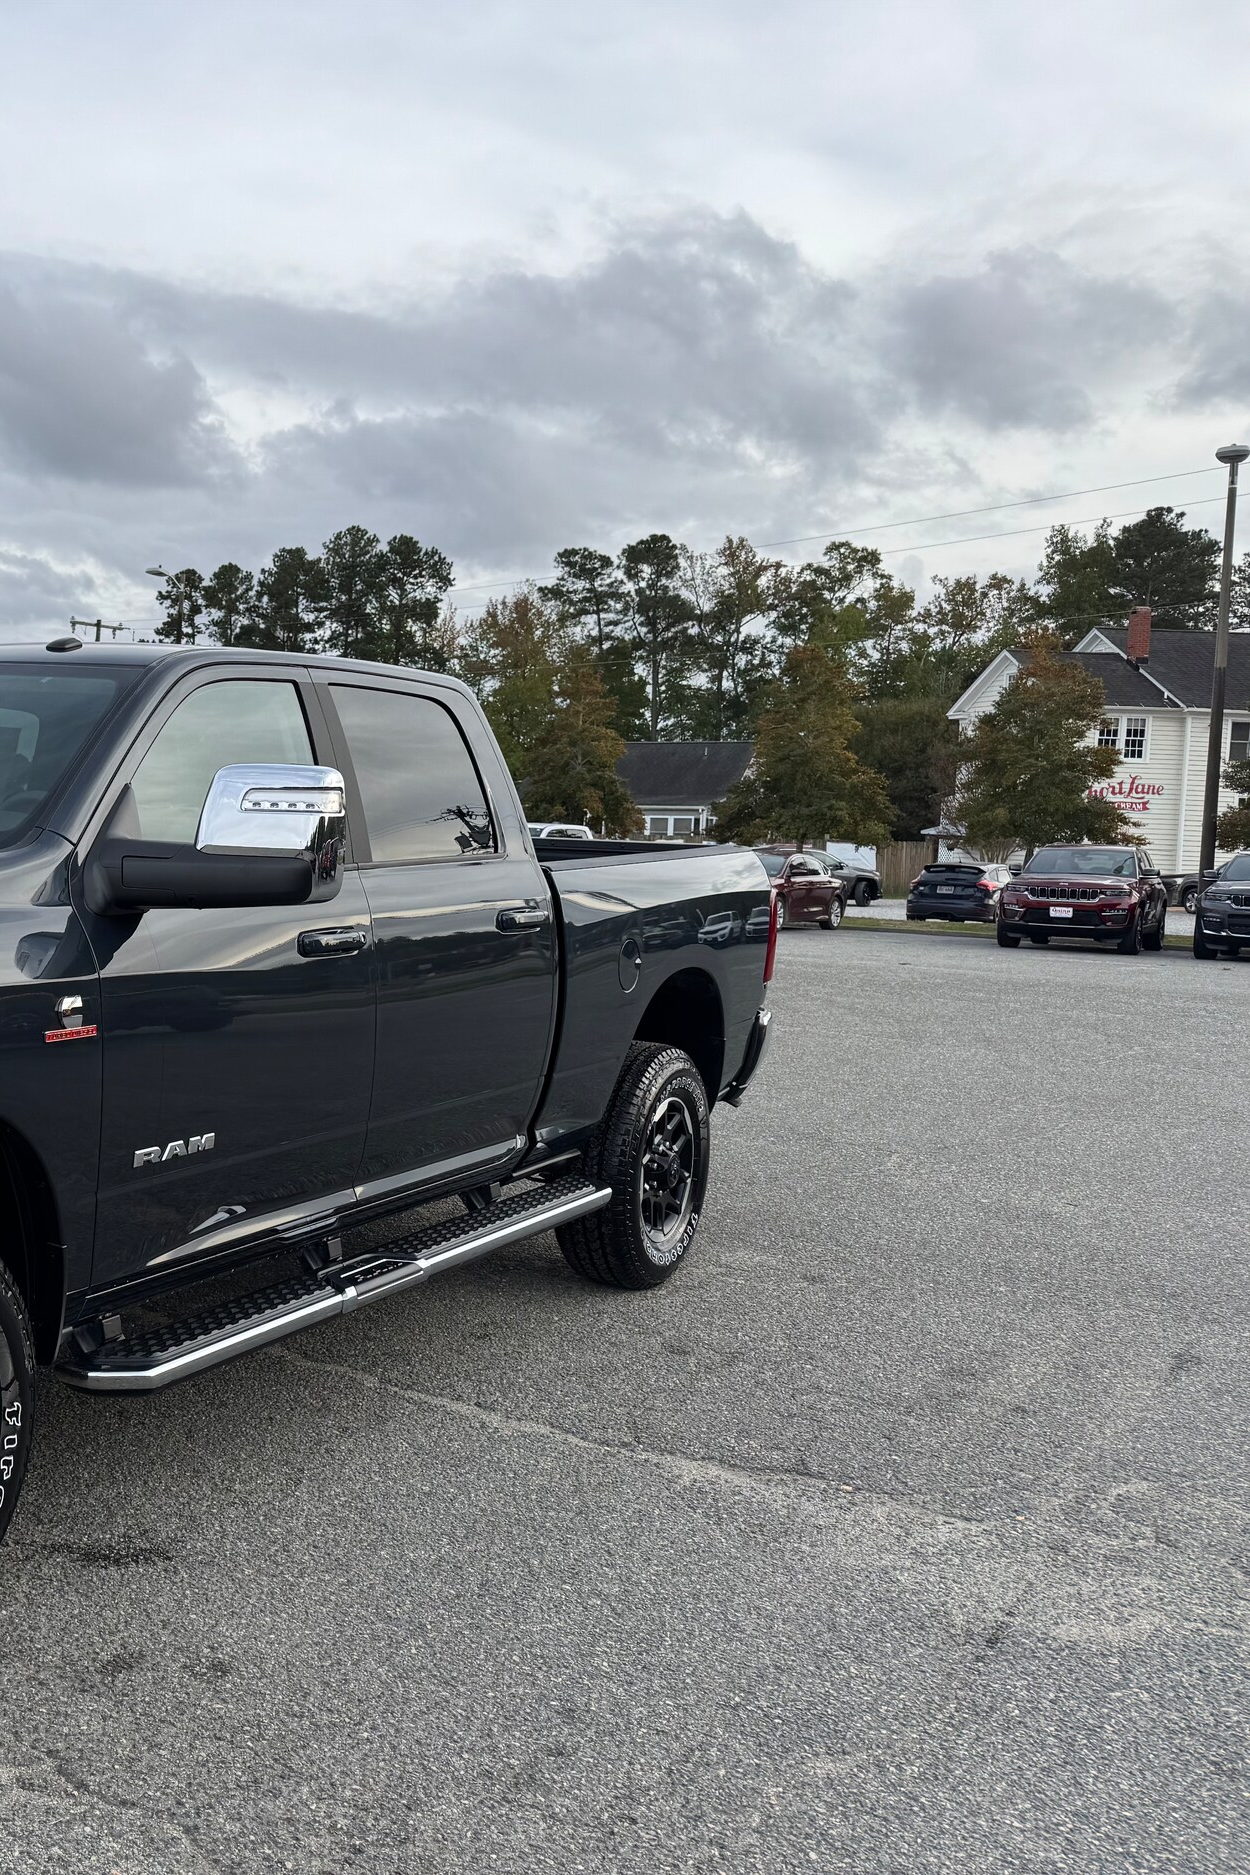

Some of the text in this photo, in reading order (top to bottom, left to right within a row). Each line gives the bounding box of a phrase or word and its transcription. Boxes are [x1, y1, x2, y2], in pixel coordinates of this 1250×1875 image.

[1087, 774, 1164, 800] hort Lane
[133, 1131, 217, 1168] RAM
